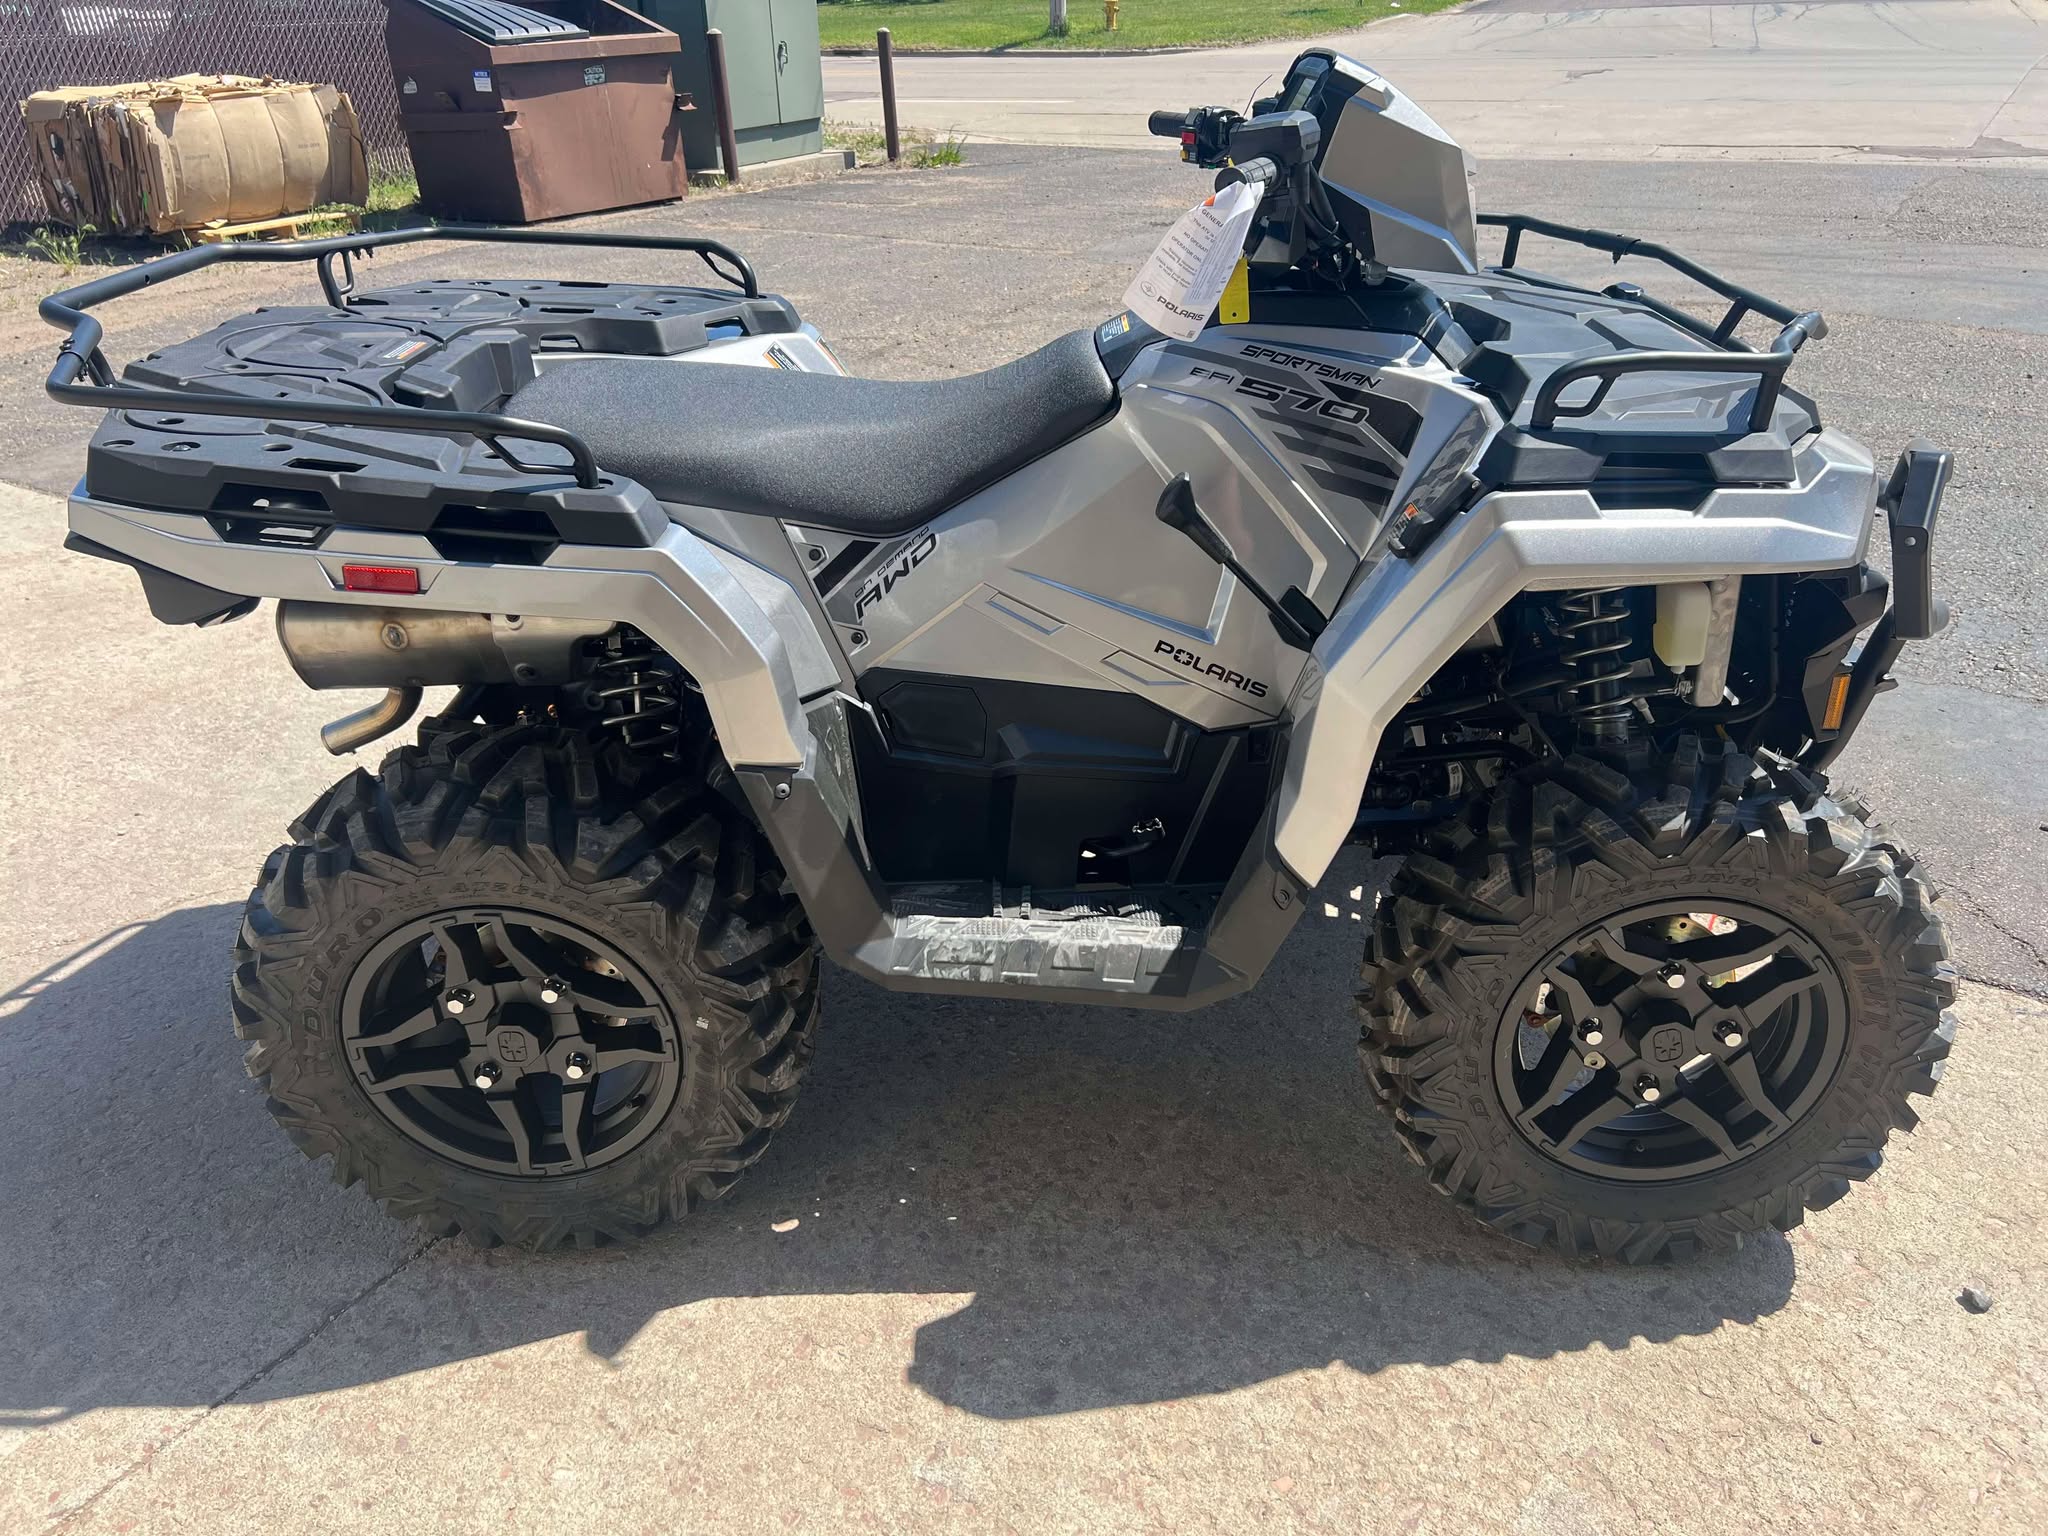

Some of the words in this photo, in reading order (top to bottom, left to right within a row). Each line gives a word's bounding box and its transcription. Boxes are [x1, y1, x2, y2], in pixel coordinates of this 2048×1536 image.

[1171, 236, 1194, 257] OPERATOR
[1192, 254, 1202, 263] ONL
[1156, 295, 1205, 322] POLARIS
[1189, 366, 1235, 385] EFI
[1234, 376, 1370, 425] 570
[1240, 343, 1384, 389] SPORTSMAN
[854, 532, 938, 620] AWD
[1153, 639, 1269, 698] POLARIS
[302, 907, 384, 1040] DURO
[1464, 977, 1506, 1119] DURO
